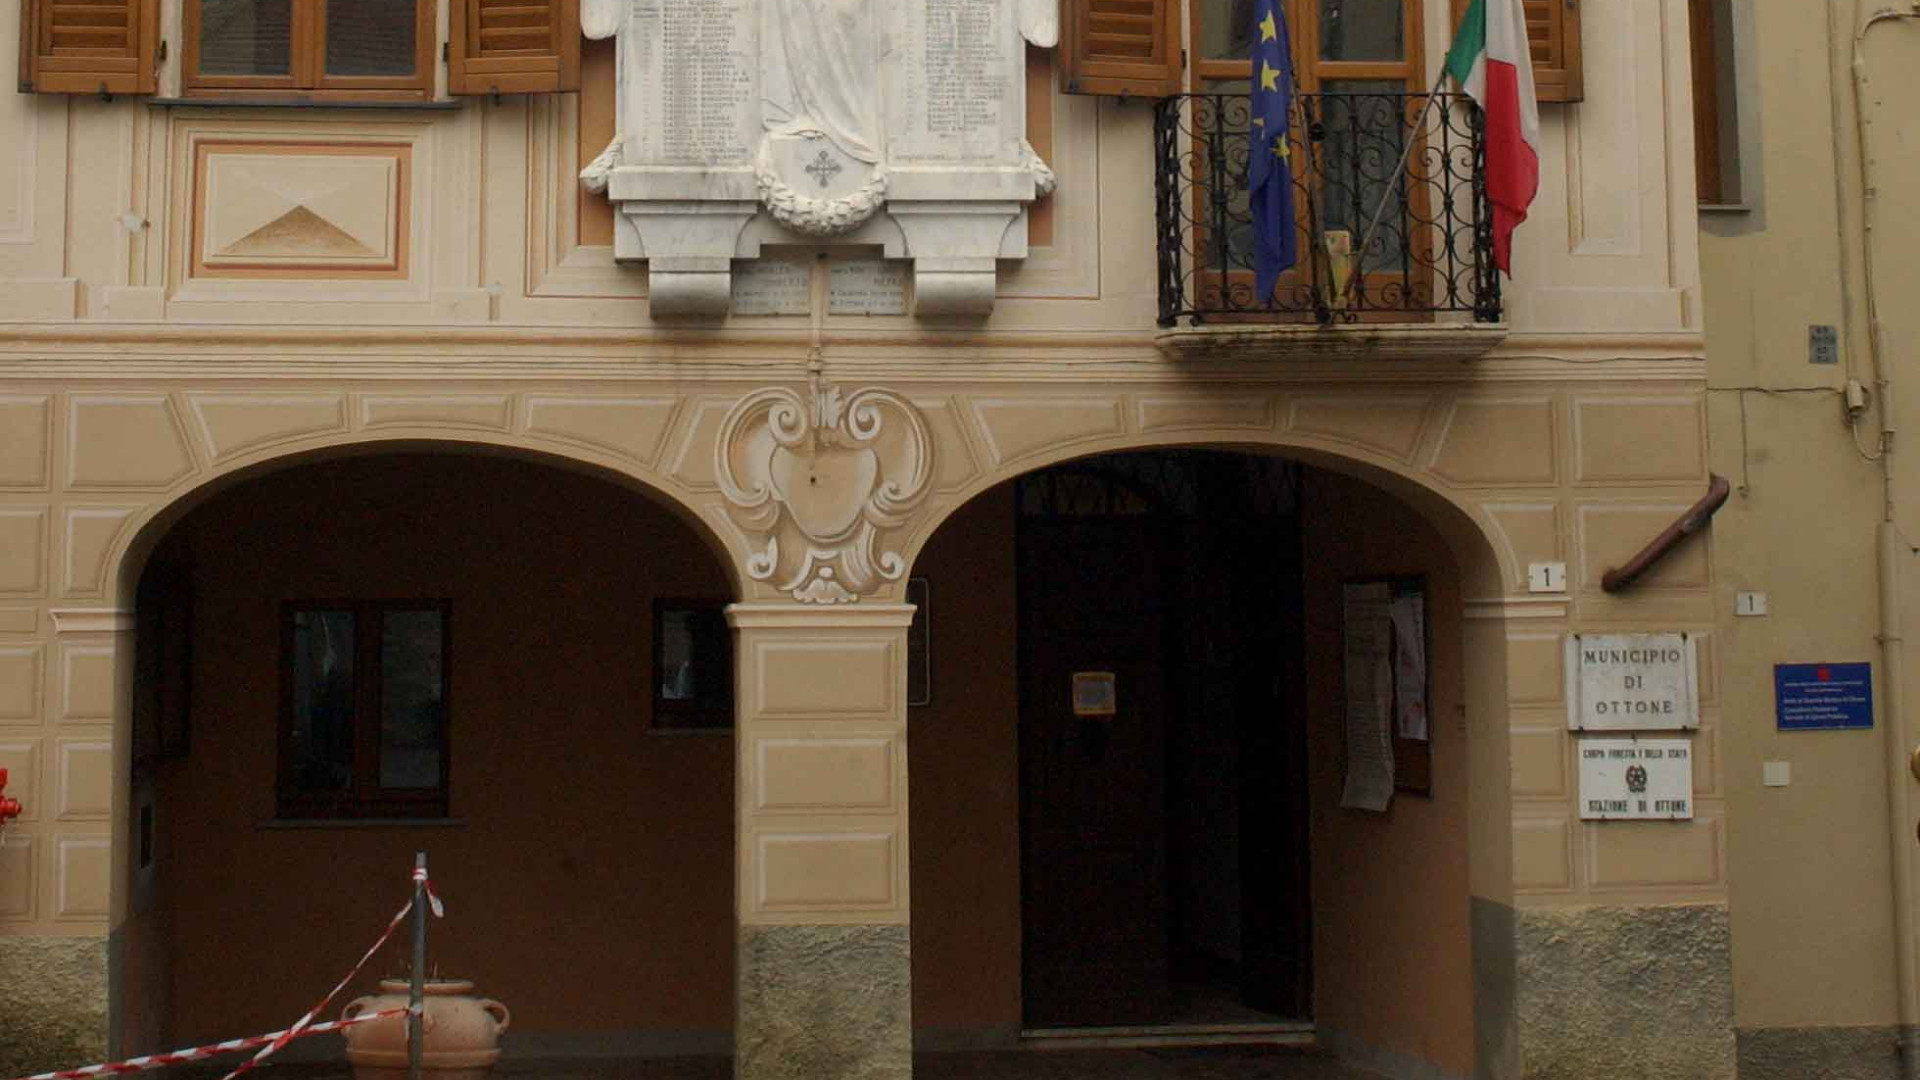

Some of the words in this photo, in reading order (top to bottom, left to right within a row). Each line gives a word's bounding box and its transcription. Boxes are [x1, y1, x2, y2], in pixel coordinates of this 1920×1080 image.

[1543, 567, 1550, 587] 1
[1748, 594, 1754, 612] 1
[1584, 649, 1680, 664] MUNICIPIO
[1624, 675, 1643, 689] DI
[1596, 700, 1673, 714] OTTONE
[1589, 800, 1628, 812] STAZIONE
[1638, 800, 1647, 812] DI
[1655, 800, 1686, 812] OTTONE
